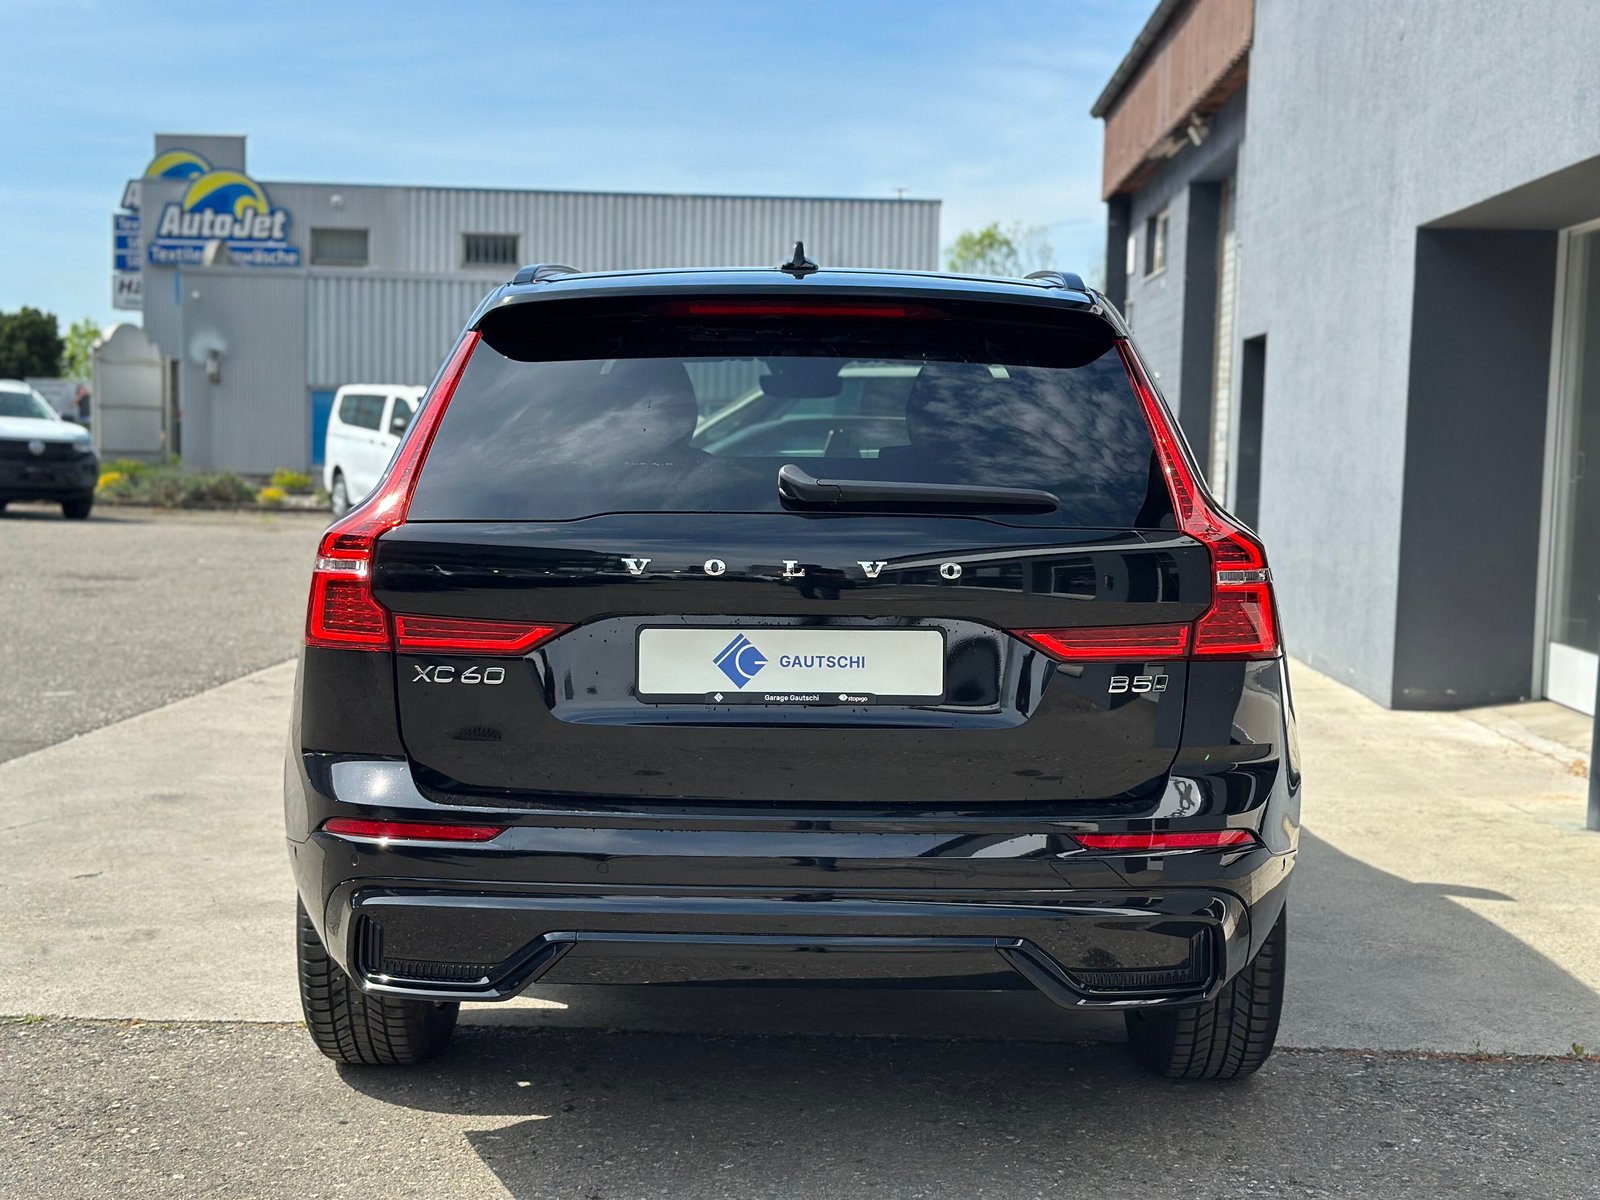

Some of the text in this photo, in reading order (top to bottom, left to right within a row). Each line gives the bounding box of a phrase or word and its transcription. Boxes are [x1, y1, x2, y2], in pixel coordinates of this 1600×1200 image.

[159, 206, 286, 239] AutoJet
[621, 557, 962, 579] VOLVO
[779, 655, 865, 668] GAUTSCHI
[1108, 676, 1153, 693] B5
[764, 694, 820, 702] Garage Gautschi
